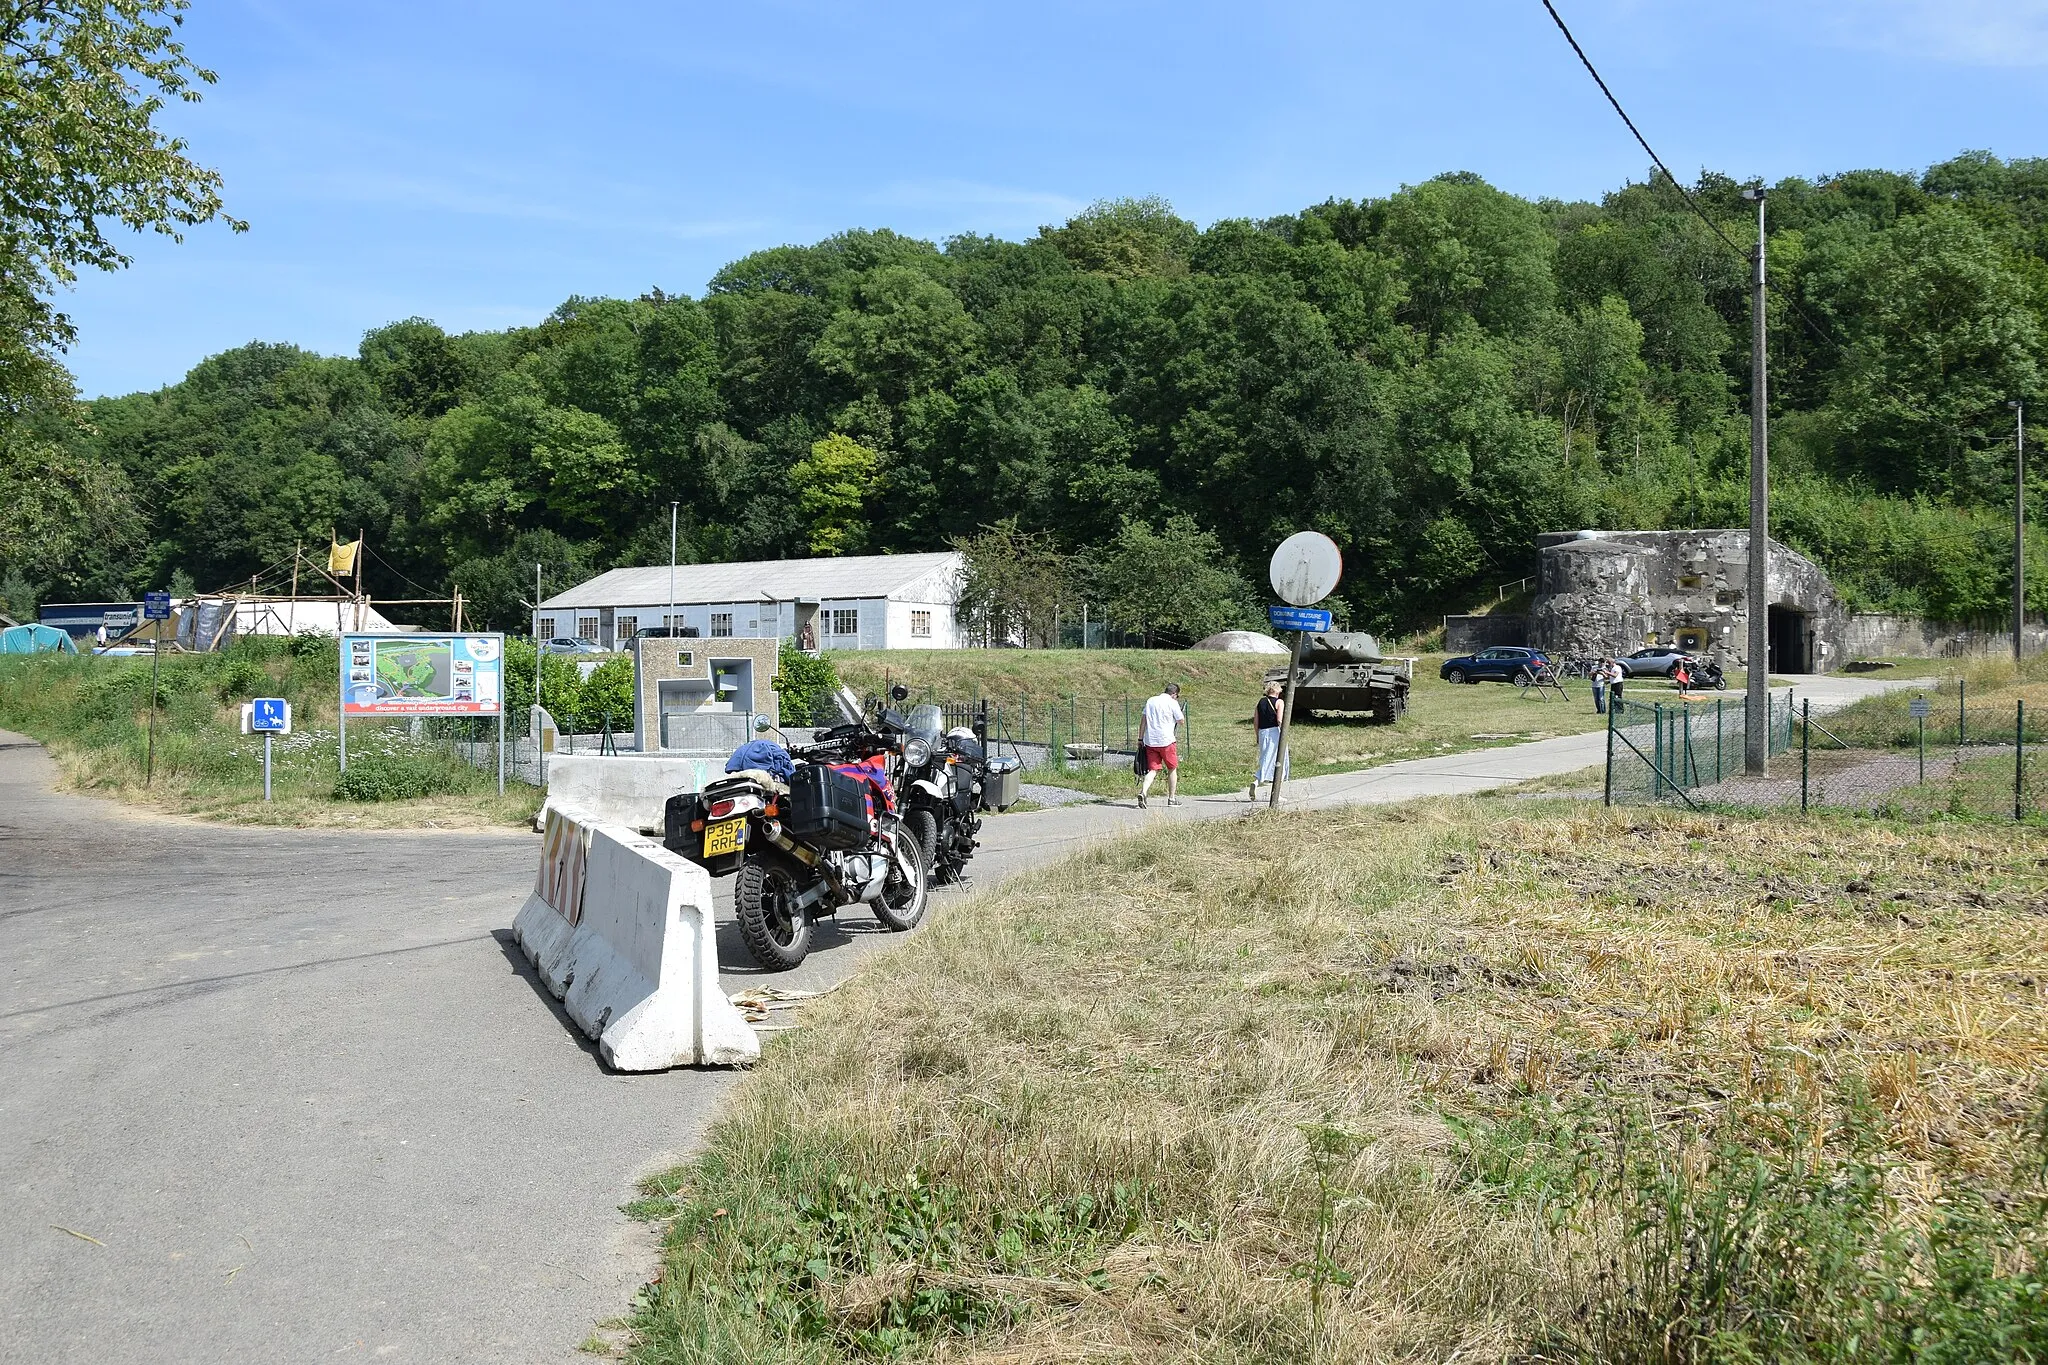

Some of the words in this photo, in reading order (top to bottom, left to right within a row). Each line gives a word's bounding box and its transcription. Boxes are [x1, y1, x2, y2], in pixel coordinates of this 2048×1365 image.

[418, 705, 457, 713] underground
[707, 820, 743, 839] P397
[711, 835, 738, 852] RRH
